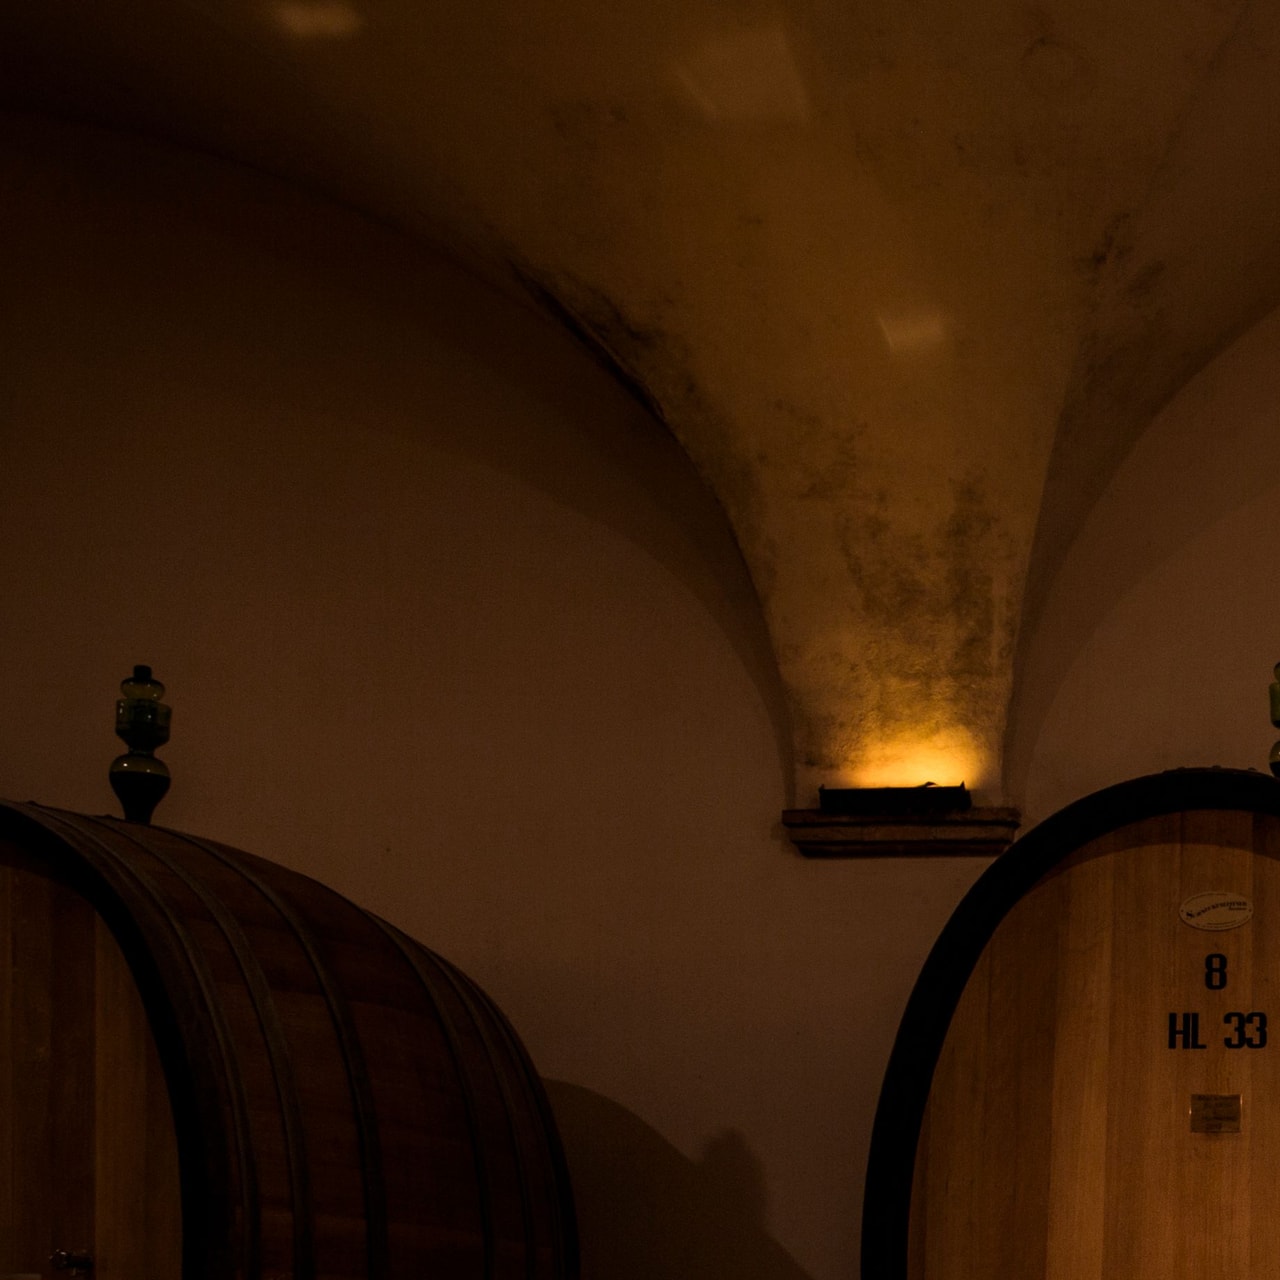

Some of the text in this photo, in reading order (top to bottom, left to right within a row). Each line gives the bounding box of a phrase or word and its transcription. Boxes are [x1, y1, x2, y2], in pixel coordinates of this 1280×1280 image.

[1204, 952, 1228, 991] 8
[1167, 1011, 1267, 1050] HL 33
